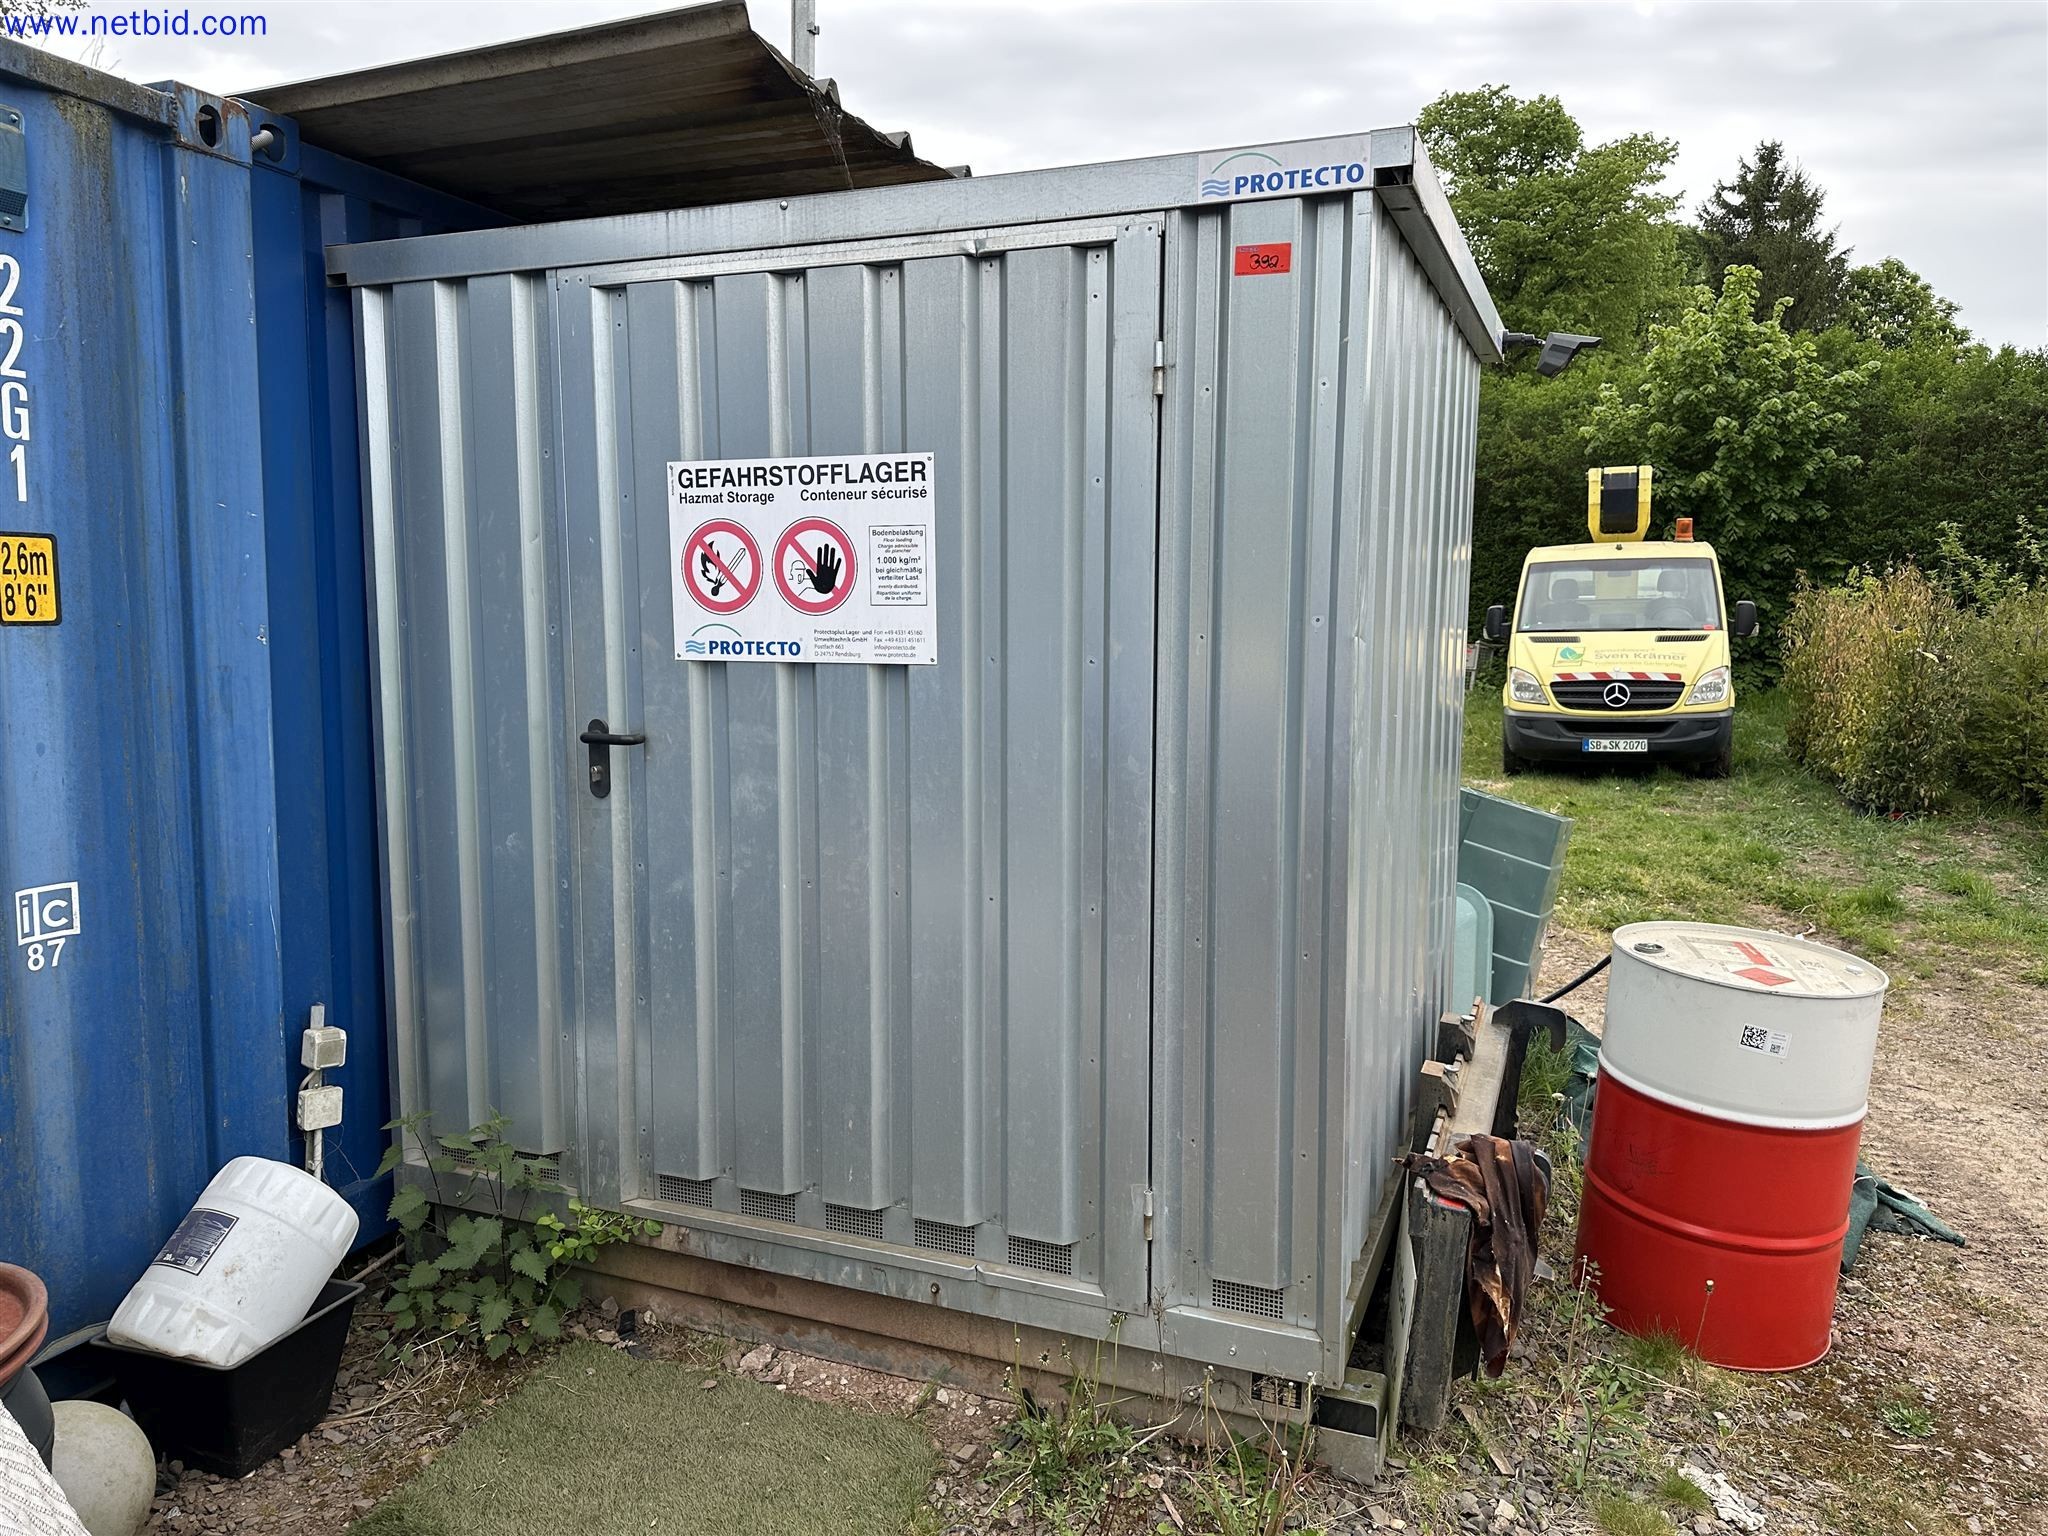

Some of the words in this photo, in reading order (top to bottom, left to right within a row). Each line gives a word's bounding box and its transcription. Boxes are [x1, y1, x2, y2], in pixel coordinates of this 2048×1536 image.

[1234, 163, 1364, 195] PROTECTO
[677, 460, 927, 489] GEFAHRSTOFFLAGER
[679, 492, 724, 504] Hazmat
[727, 492, 775, 506] Storage
[800, 488, 868, 501] Conteneur
[871, 486, 928, 499] sécurisé
[1, 541, 48, 581] 2,6m
[876, 556, 897, 564] 1.000
[708, 640, 801, 656] PROTECTO
[1594, 652, 1629, 660] Sven
[1633, 652, 1687, 661] Krämer
[1590, 740, 1602, 750] SB
[1608, 740, 1621, 750] SK
[1622, 740, 1646, 750] 2070
[27, 937, 66, 971] 87
